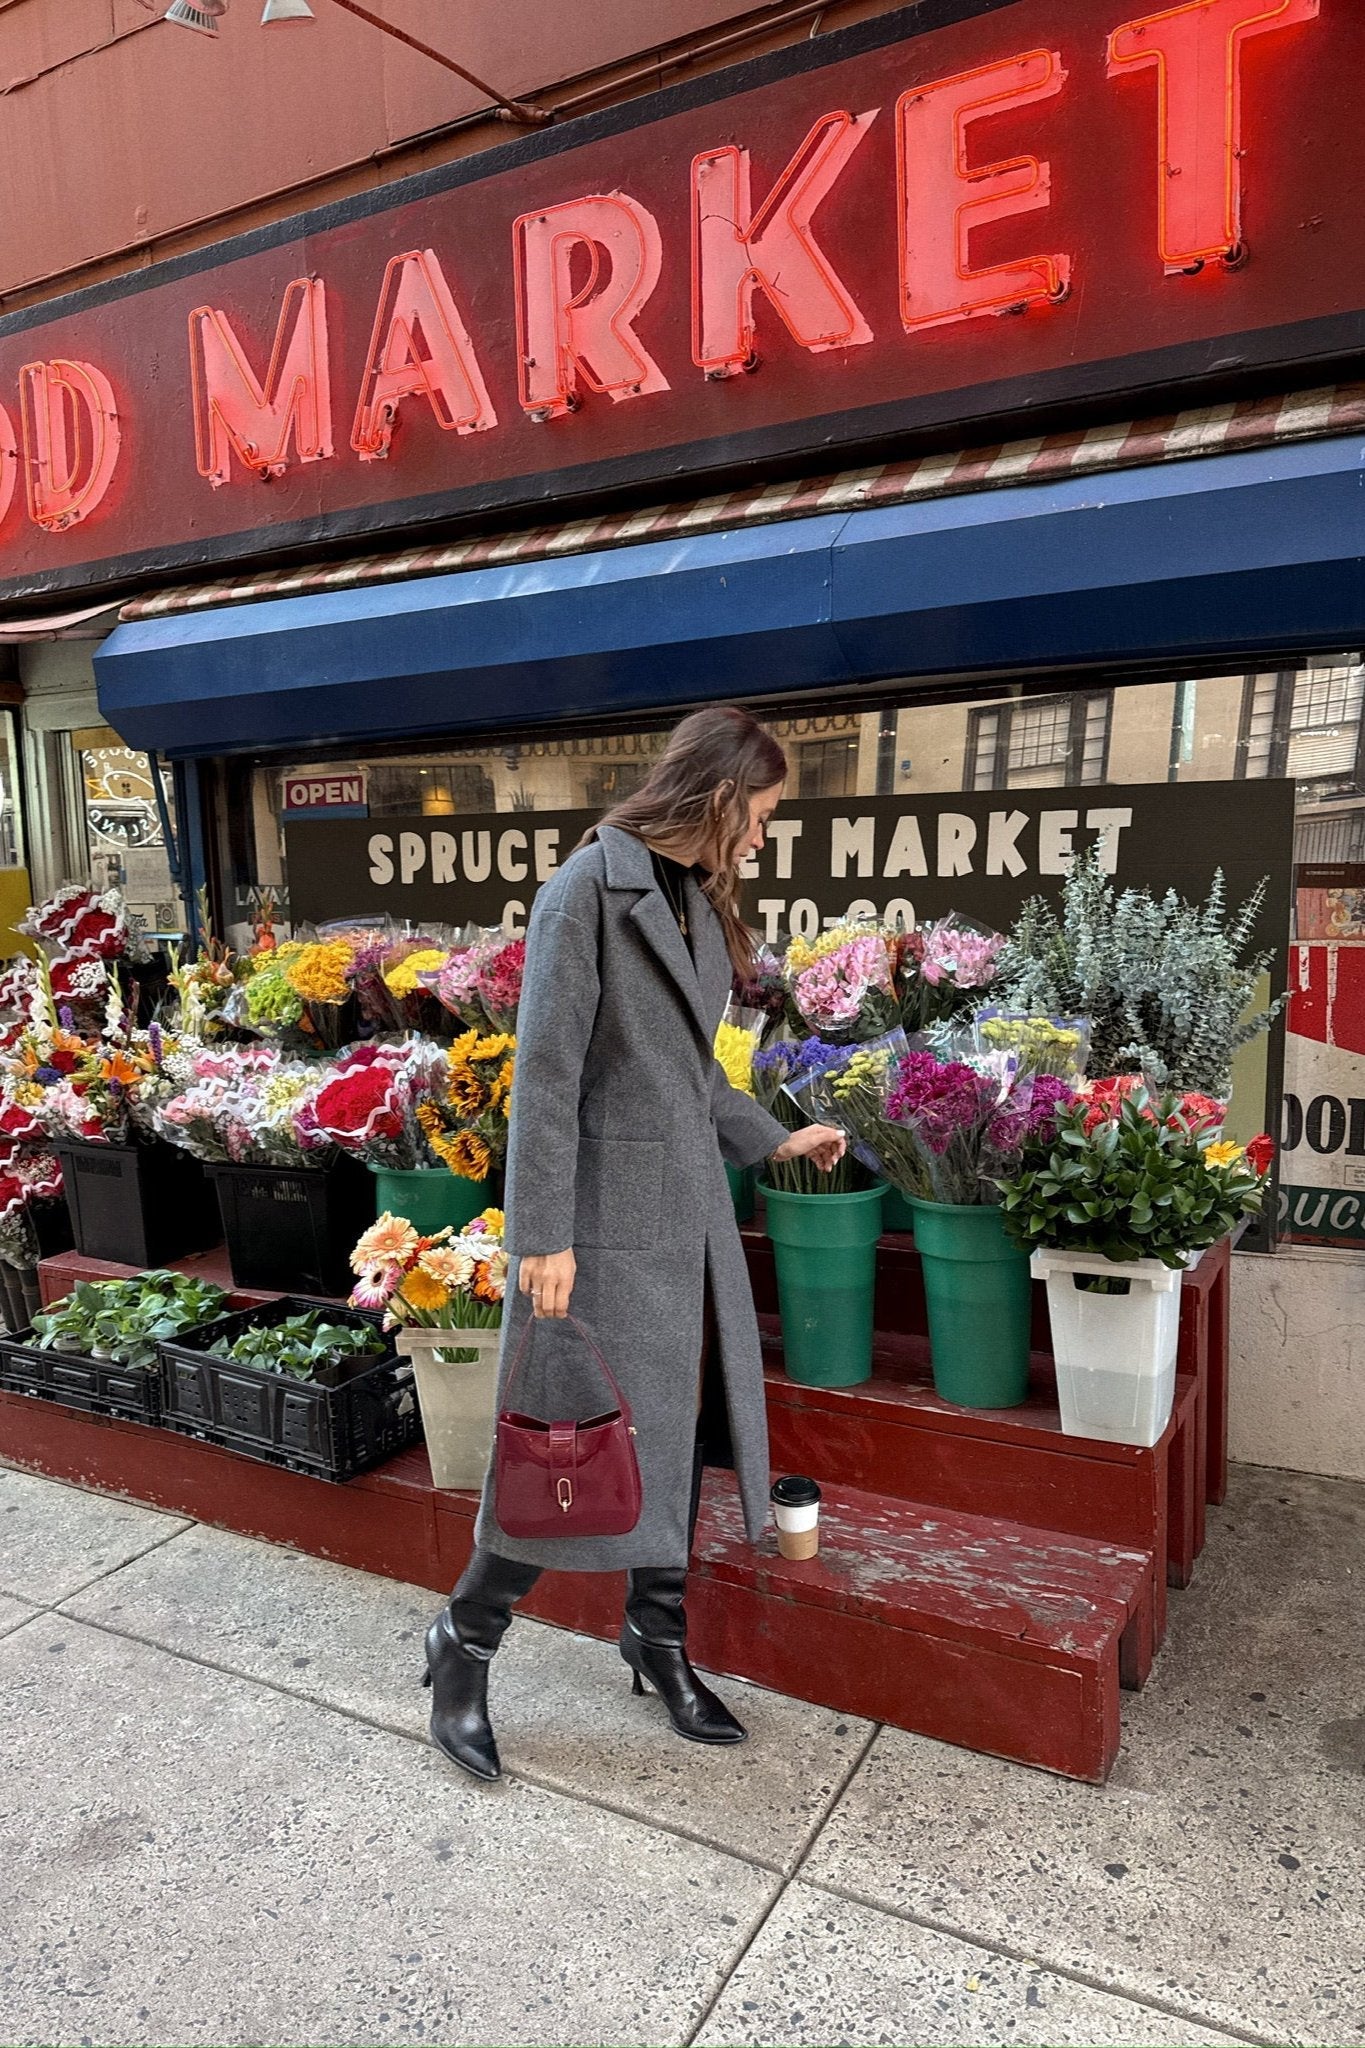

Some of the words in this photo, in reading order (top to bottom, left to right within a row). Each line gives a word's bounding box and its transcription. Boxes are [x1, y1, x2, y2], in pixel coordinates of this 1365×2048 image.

[188, 0, 1320, 489] MARKET
[290, 780, 360, 805] OPEN
[368, 828, 561, 885] SPRUCE
[830, 807, 1133, 879] MARKET
